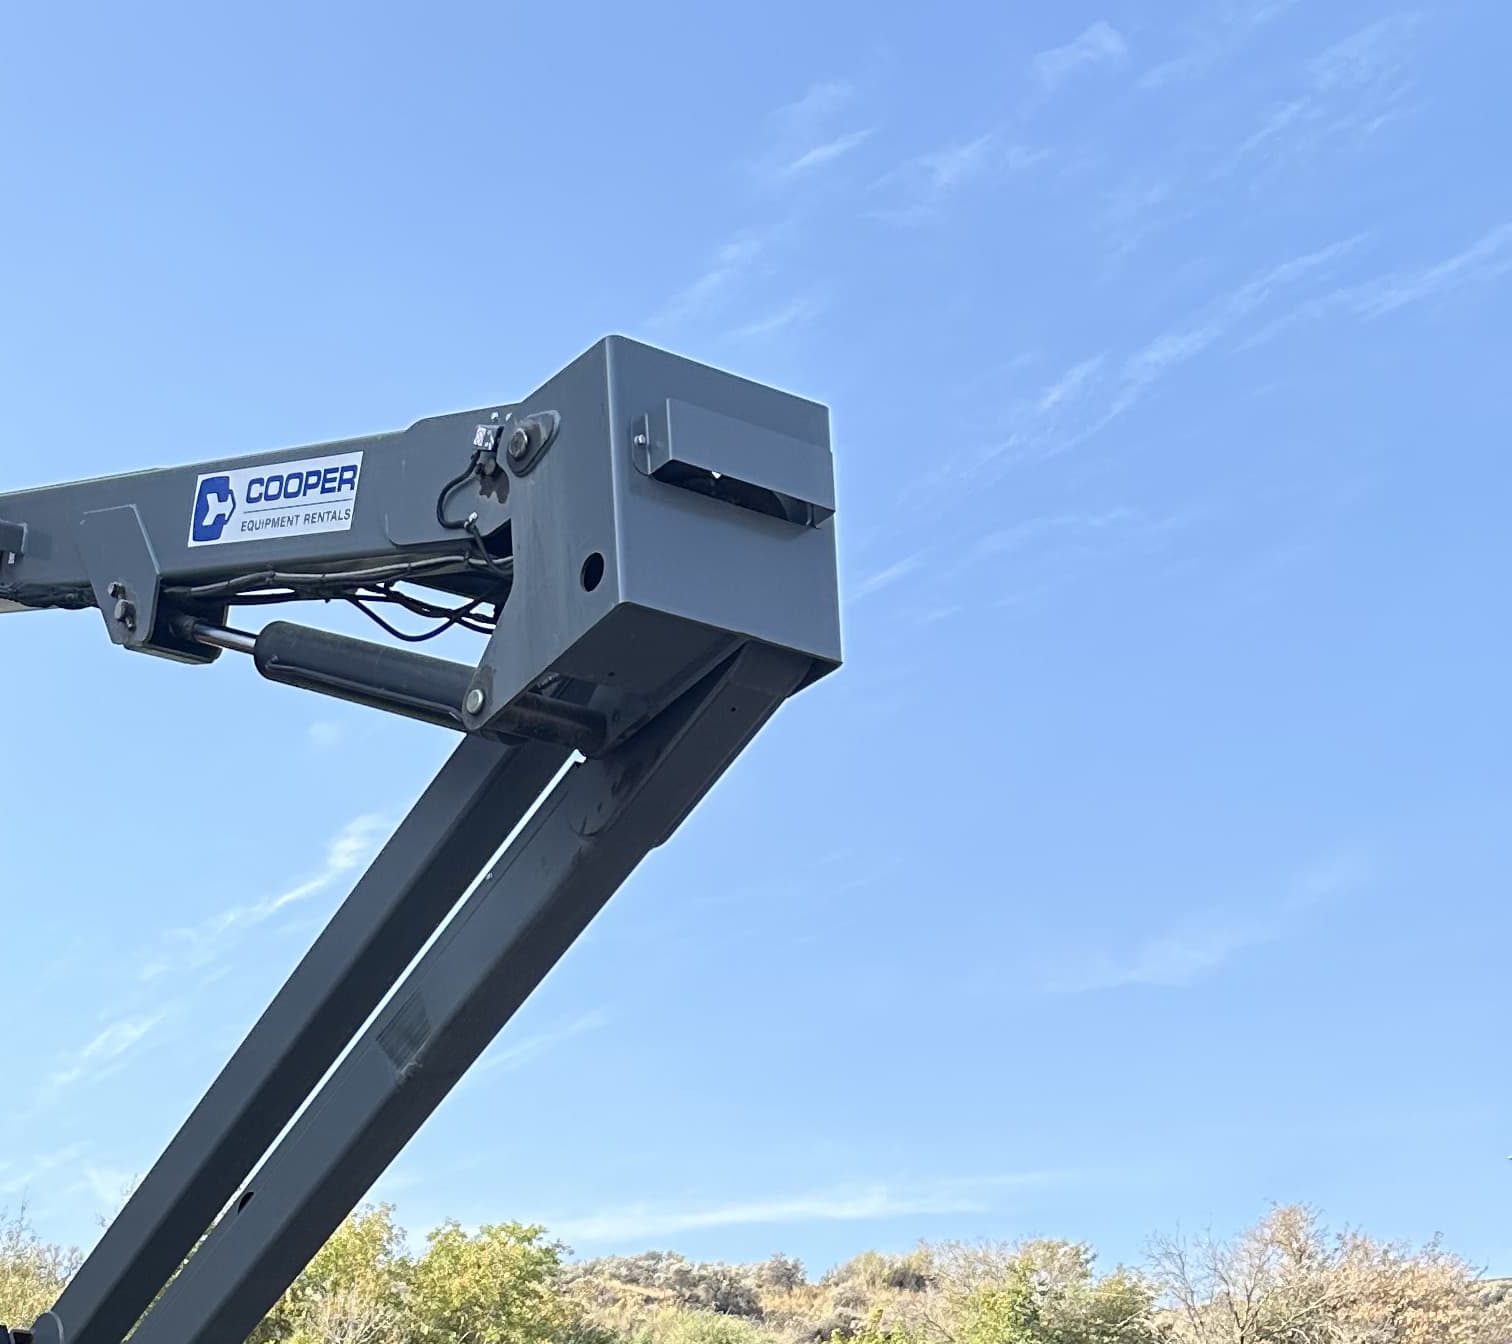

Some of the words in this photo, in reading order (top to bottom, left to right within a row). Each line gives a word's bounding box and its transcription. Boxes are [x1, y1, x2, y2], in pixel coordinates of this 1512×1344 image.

[246, 464, 358, 504] COOPER
[241, 514, 300, 532] EQUIPMENT
[303, 508, 351, 525] RENTALS
